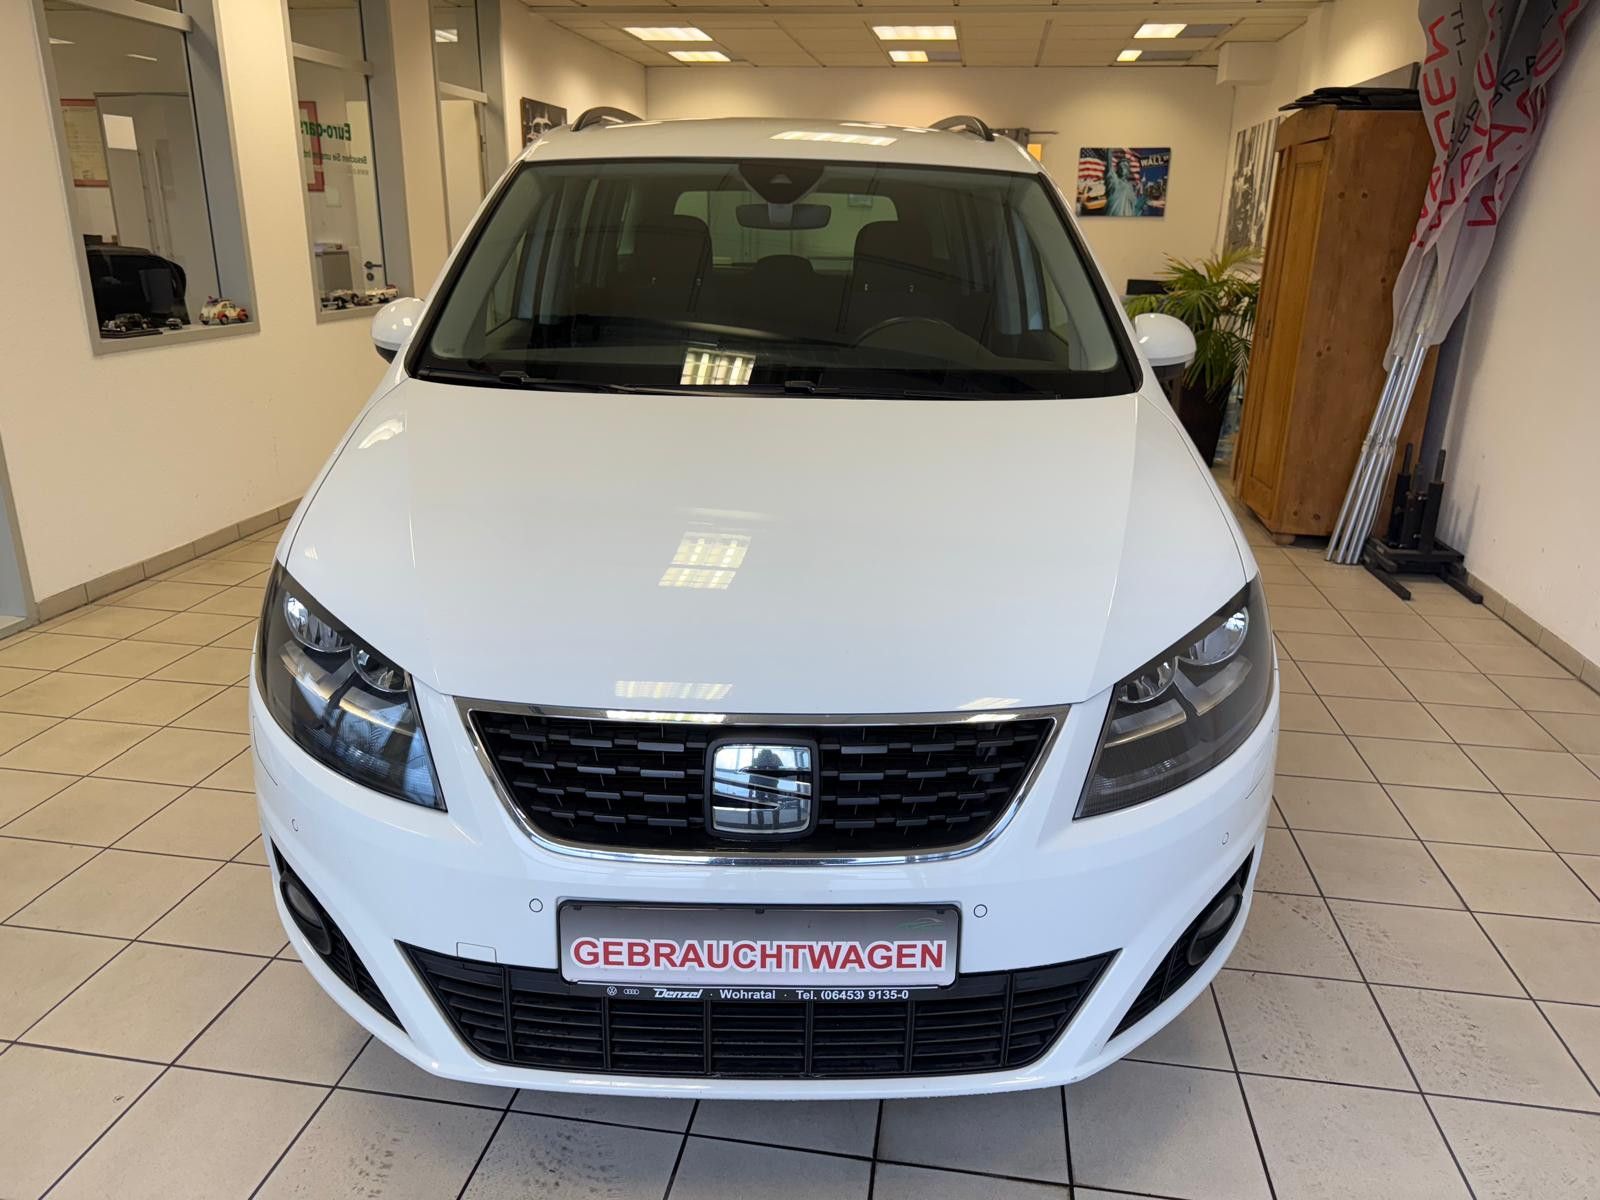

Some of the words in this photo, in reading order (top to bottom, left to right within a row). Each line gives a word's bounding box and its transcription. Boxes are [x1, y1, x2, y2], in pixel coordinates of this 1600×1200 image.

[1140, 154, 1163, 167] WALL
[572, 938, 946, 972] GEBRAUCHTWAGEN
[653, 987, 704, 999] Denzel
[719, 989, 776, 1000] Wohratal
[795, 989, 818, 1000] Tel.
[820, 989, 865, 1001] (06453)
[868, 989, 909, 1000] 9135-0
